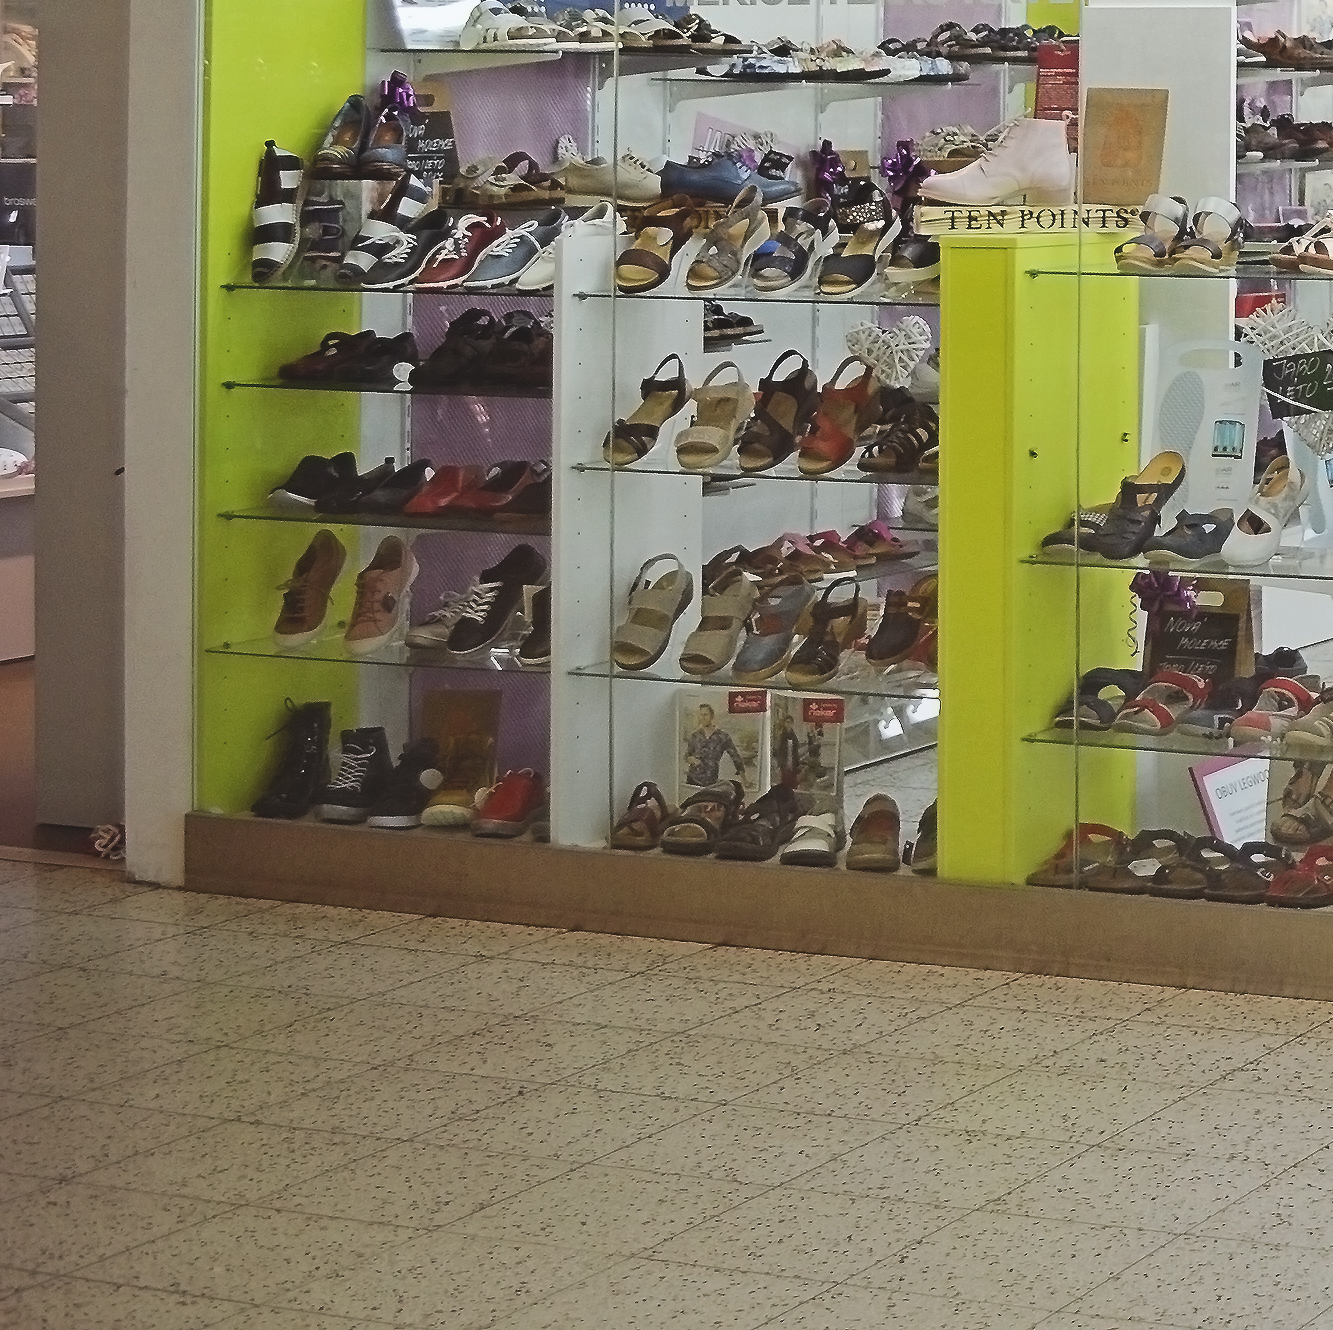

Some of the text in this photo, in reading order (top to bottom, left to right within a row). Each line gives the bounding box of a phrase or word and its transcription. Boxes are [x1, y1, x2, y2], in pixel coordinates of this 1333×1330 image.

[944, 209, 1009, 230] TEN
[1273, 357, 1320, 380] JARO
[1214, 783, 1237, 799] OBUV
